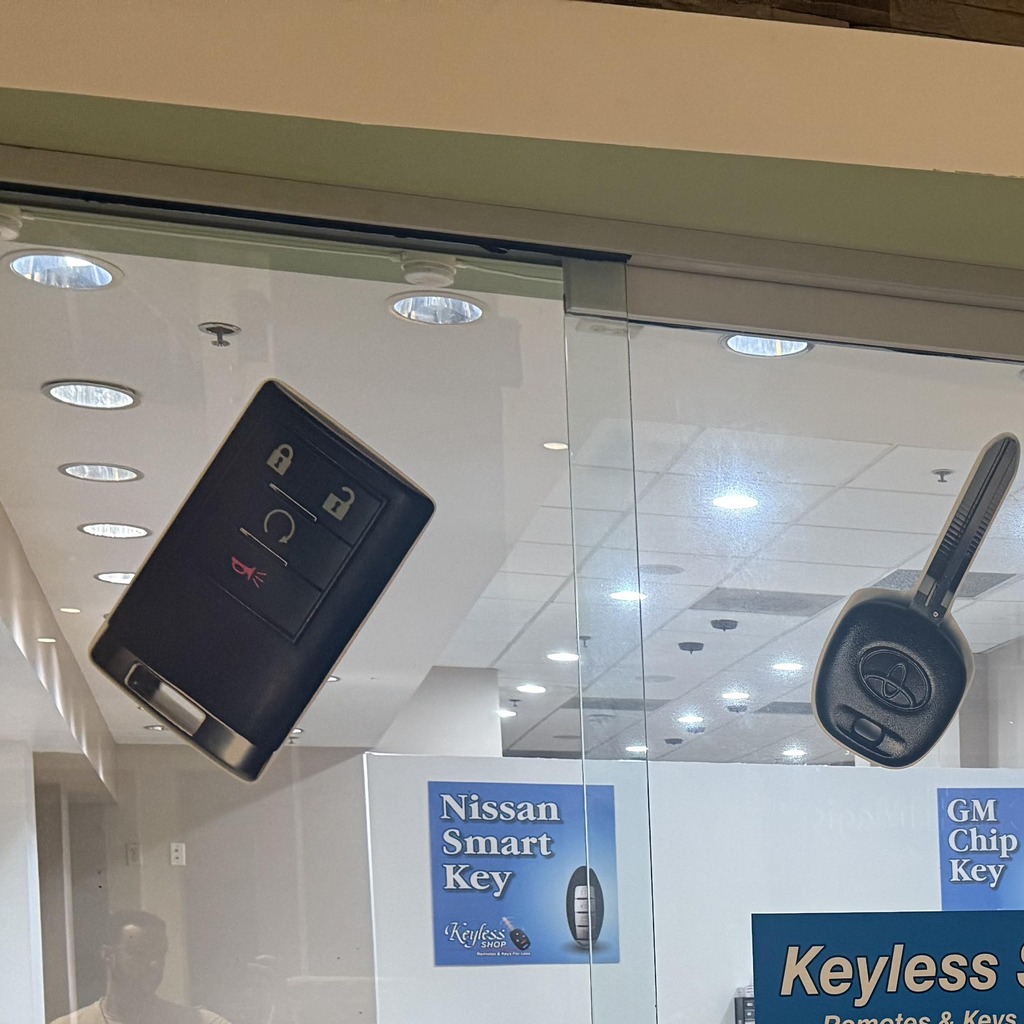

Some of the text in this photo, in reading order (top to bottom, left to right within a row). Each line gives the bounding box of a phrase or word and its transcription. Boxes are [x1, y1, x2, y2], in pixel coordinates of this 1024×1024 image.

[440, 793, 561, 822] Nissan
[947, 798, 998, 822] GM
[442, 829, 552, 856] Smart
[948, 827, 1018, 858] Chip
[443, 864, 512, 898] Key
[949, 859, 1005, 888] Key
[445, 922, 506, 948] Keyless
[780, 943, 999, 1007] Keyless
